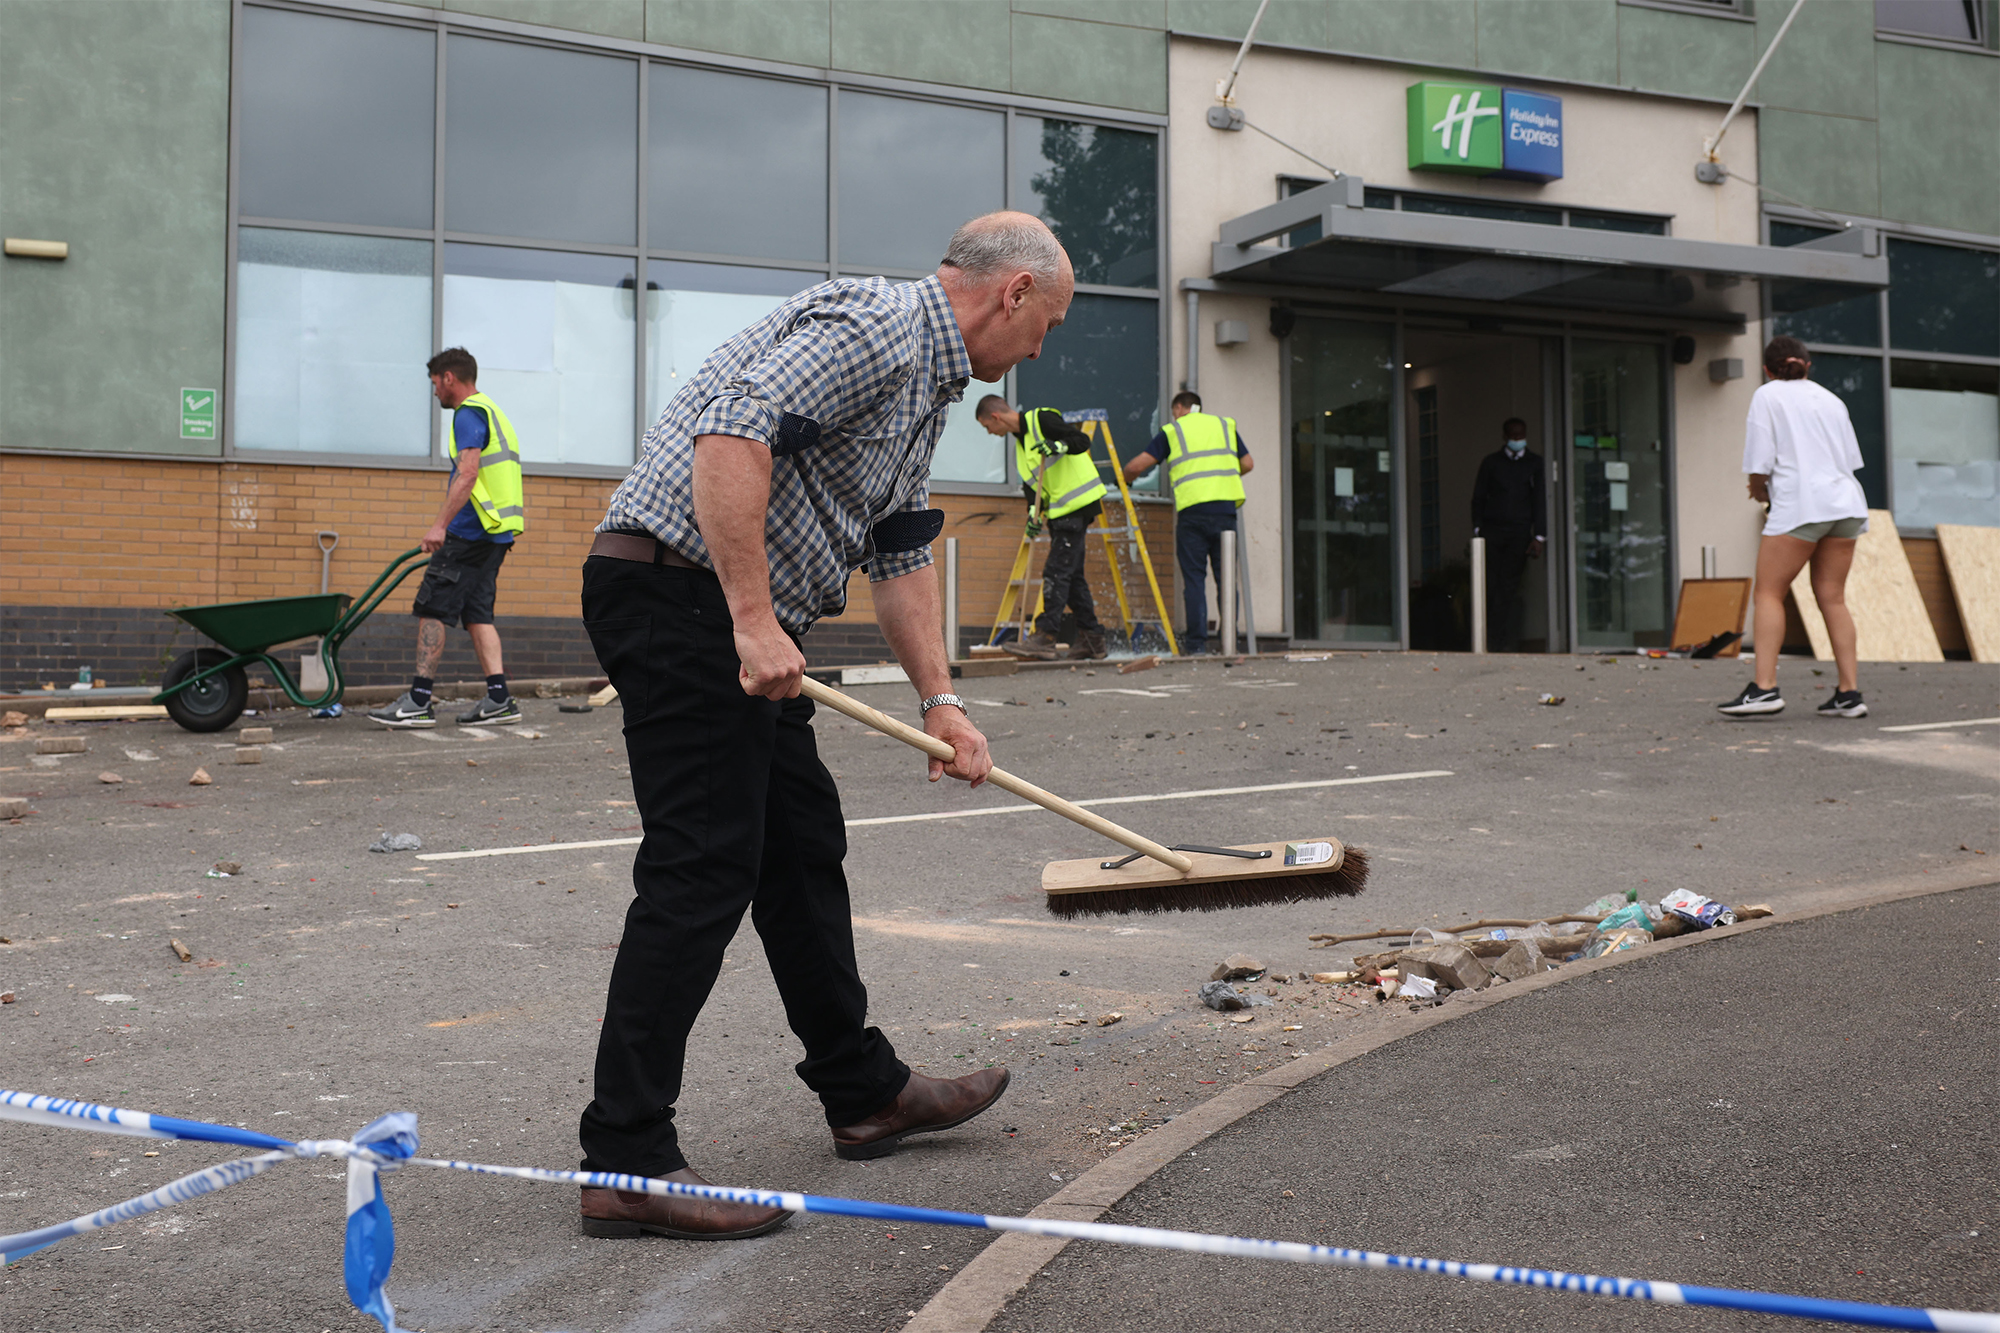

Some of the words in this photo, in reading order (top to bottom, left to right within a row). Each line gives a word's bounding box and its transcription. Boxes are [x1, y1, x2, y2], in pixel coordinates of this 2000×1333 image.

[1510, 107, 1545, 128] Holiday
[1545, 113, 1559, 128] Inn
[1510, 122, 1559, 147] Express
